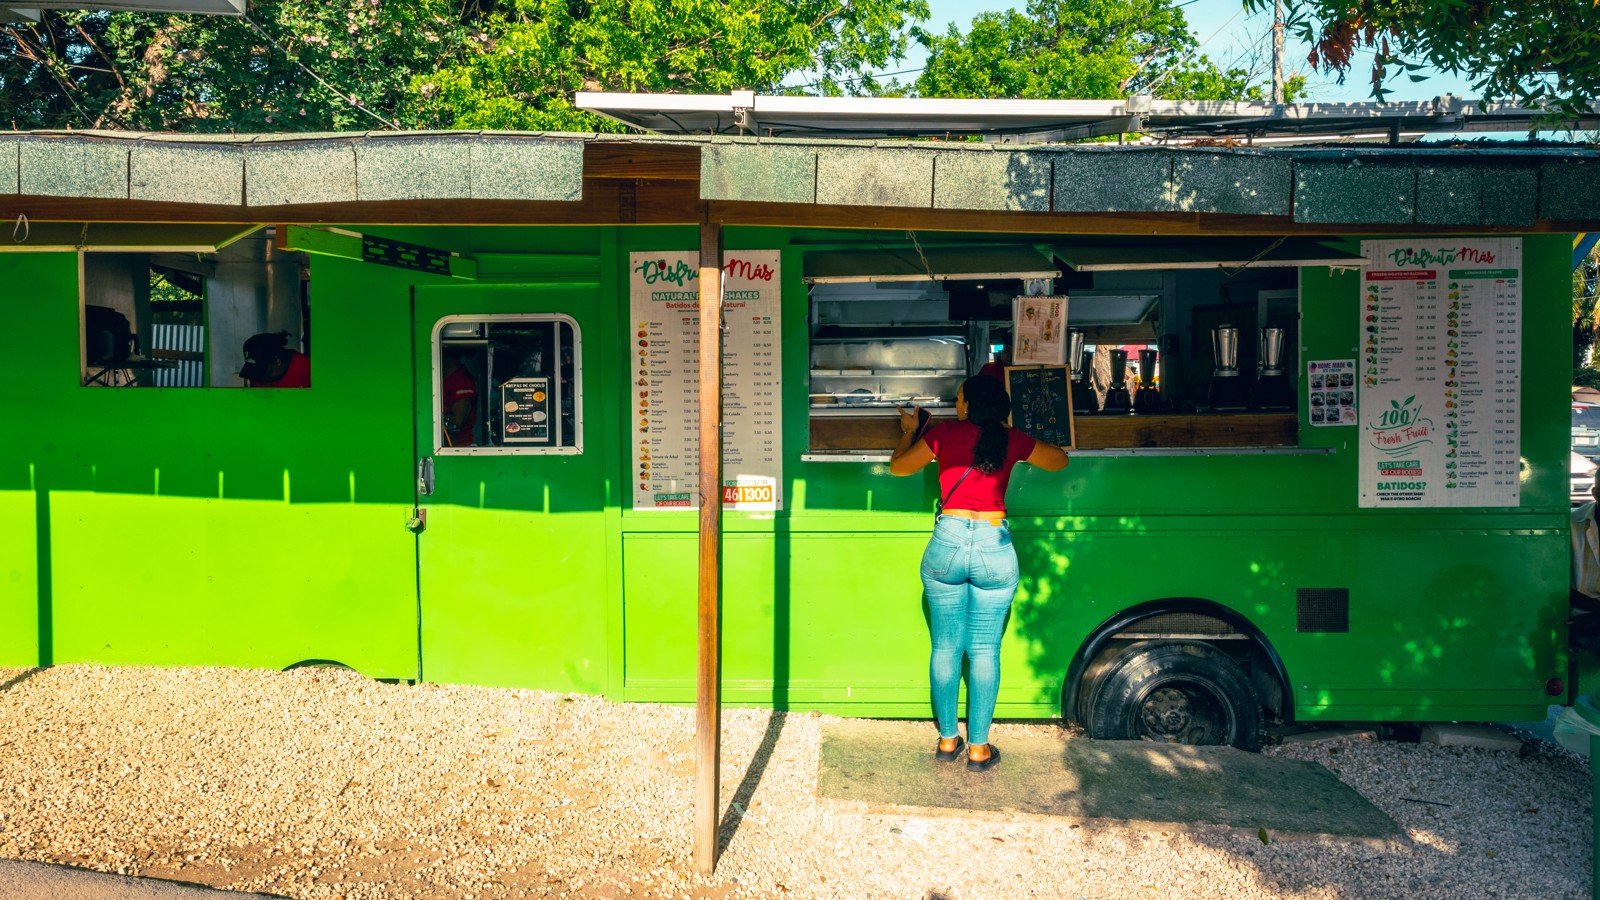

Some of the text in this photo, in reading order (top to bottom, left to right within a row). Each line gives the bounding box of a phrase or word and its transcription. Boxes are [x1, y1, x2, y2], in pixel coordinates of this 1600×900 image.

[1388, 247, 1496, 268] Disfruta Más
[635, 259, 775, 286] Disfru Más
[651, 291, 695, 301] NATURAL
[1378, 405, 1423, 427] 100%
[1373, 426, 1429, 445] Fresh Fruit
[724, 487, 770, 501] 461 1300
[1377, 481, 1427, 490] BATIDOS?
